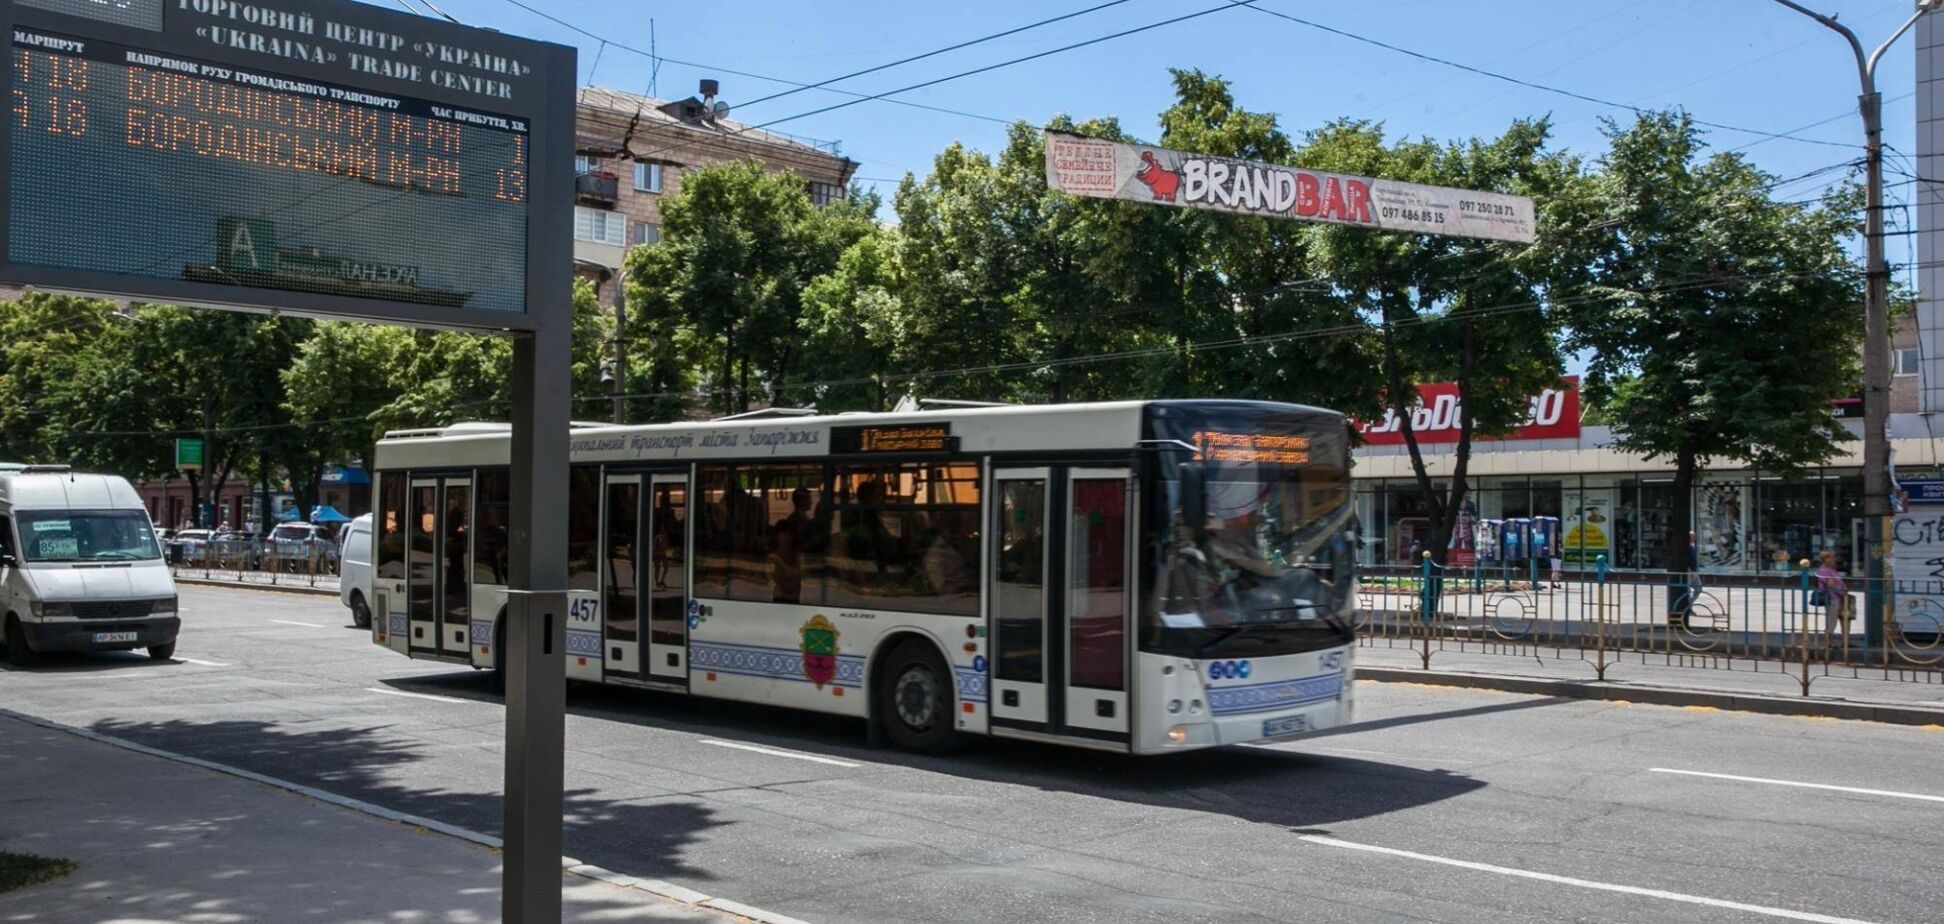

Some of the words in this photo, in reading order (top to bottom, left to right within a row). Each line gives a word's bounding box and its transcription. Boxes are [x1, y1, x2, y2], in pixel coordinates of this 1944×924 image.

[13, 30, 85, 53] МАРШРУТ
[178, 0, 315, 35] ТОРГОВИЙ
[325, 21, 404, 52] ЦЕНТР
[413, 41, 531, 77] «УКРАЇНА»
[196, 25, 337, 65] «UKRAINA»
[348, 53, 422, 82] TRADE
[430, 69, 512, 100] CENTER
[126, 51, 198, 74] НАПРЯМОК
[201, 65, 232, 80] РУХУ
[234, 72, 327, 97] ГРОМАДСЬКОГО
[329, 87, 401, 109] ТРАНСПОРТУ
[431, 106, 452, 119] ЧАС
[454, 109, 509, 129] ПРИБУТТЯ,
[511, 121, 527, 132] ХВ.
[48, 96, 86, 136] 18
[495, 168, 525, 201] 13
[513, 133, 525, 165] 1
[1057, 172, 1113, 186] ТРАДИЦИИ
[1382, 206, 1399, 219] 097
[1401, 208, 1419, 222] 486
[1421, 211, 1432, 223] 85
[1434, 212, 1445, 224] 15
[1459, 200, 1475, 212] 097
[1477, 201, 1492, 214] 250
[699, 430, 738, 448] міста
[41, 542, 55, 553] 85
